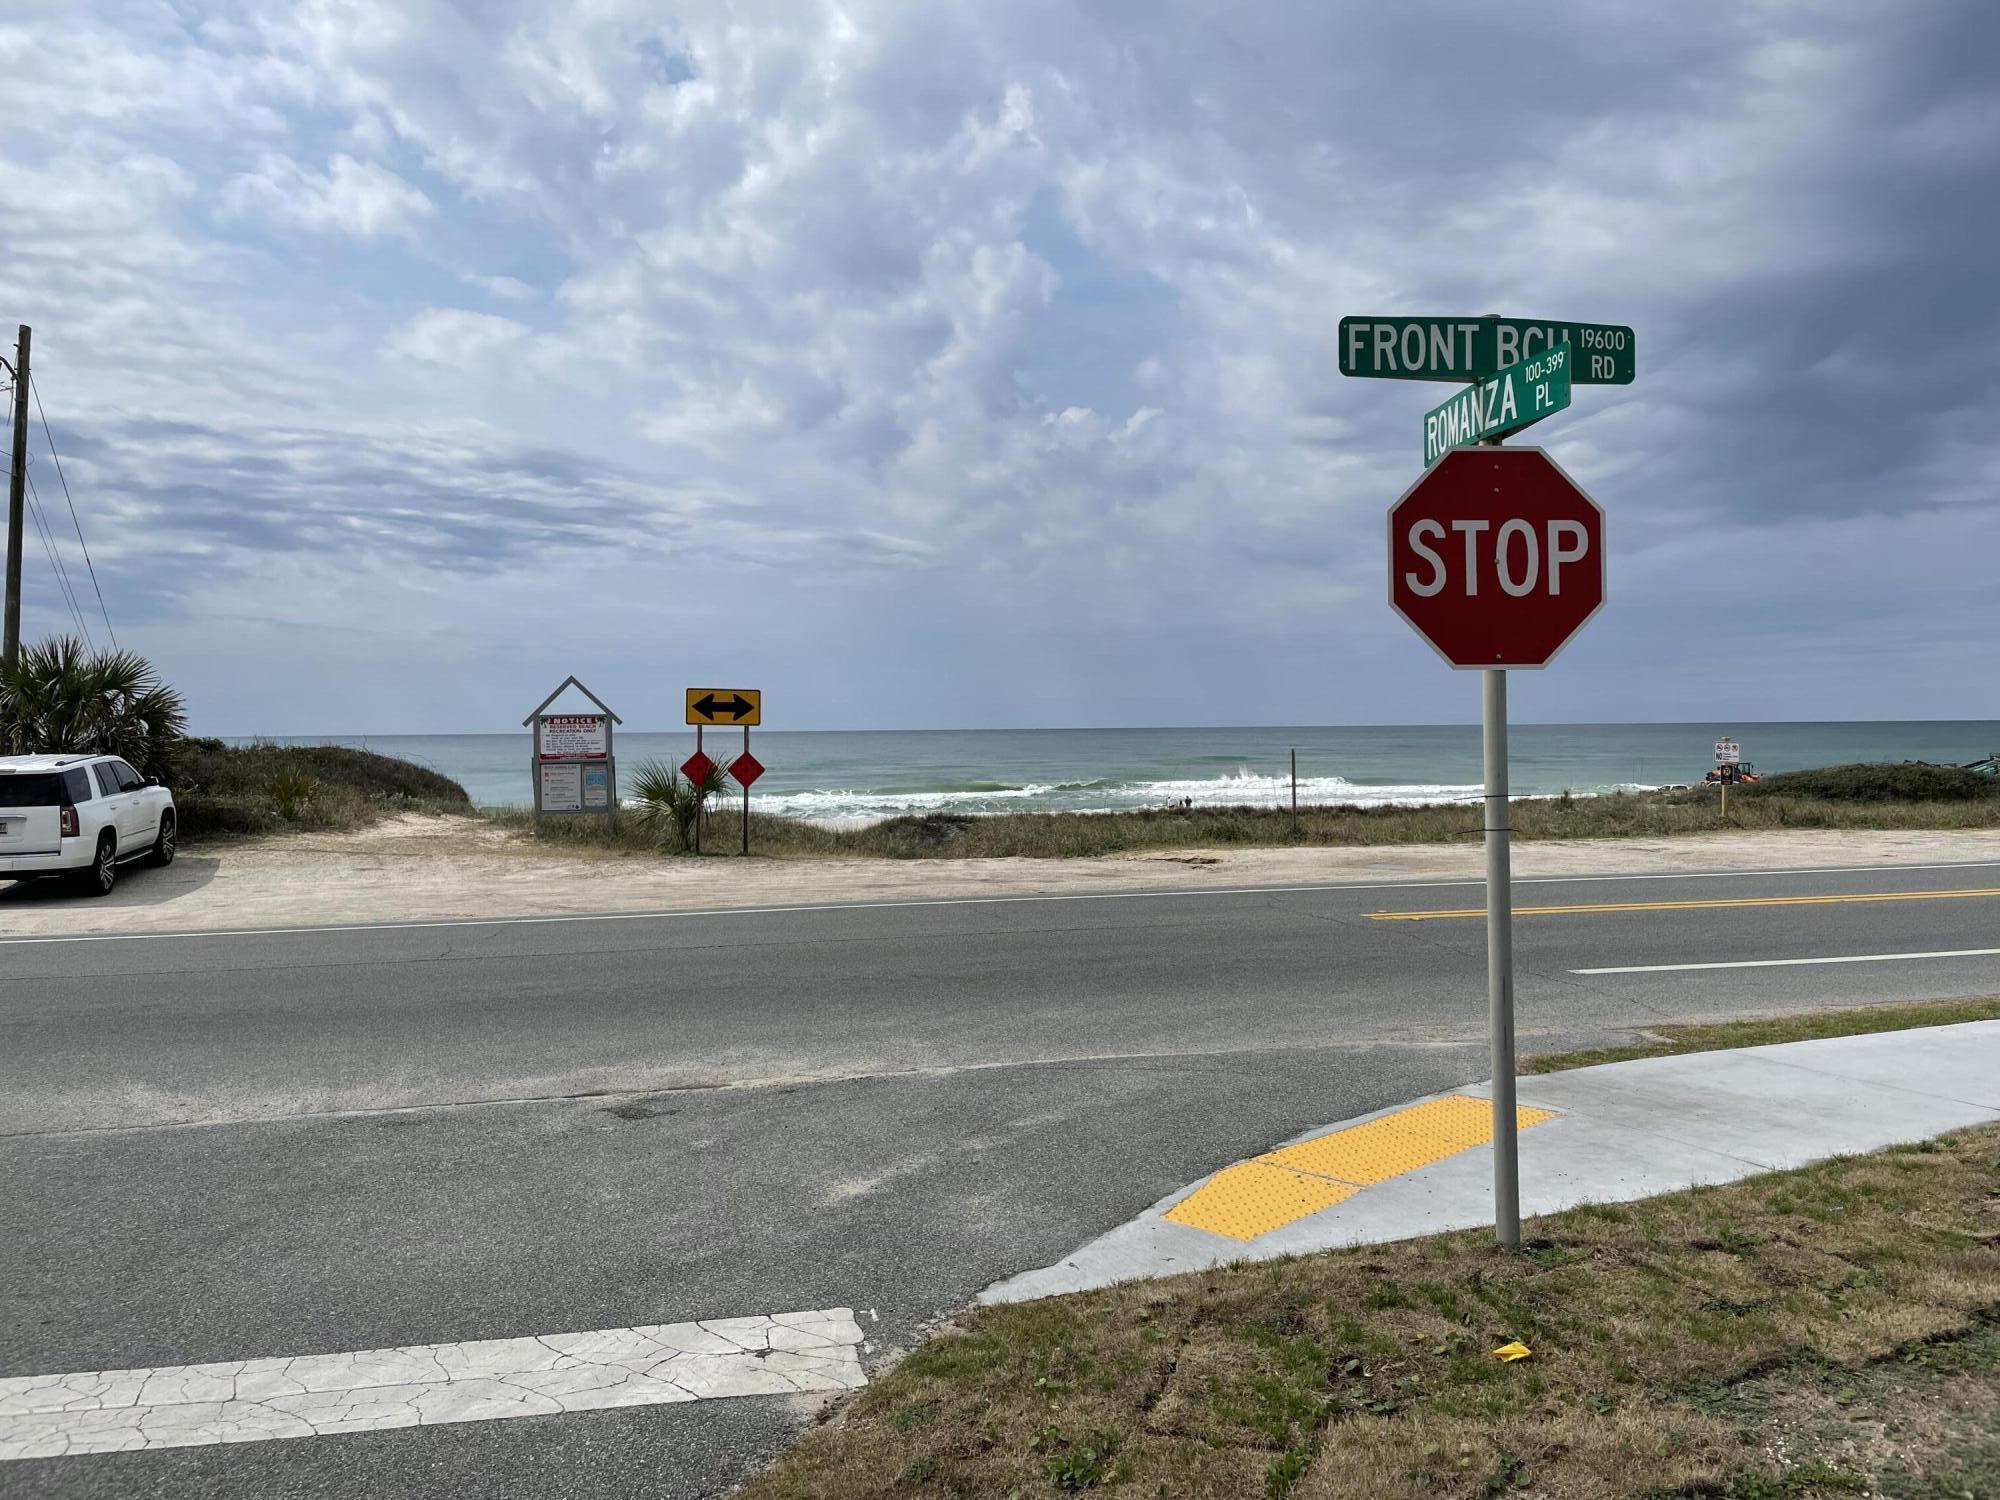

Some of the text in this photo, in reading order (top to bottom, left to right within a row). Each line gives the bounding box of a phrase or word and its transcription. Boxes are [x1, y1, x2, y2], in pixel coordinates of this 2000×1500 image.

[1349, 323, 1480, 371] FRONT
[1580, 328, 1625, 351] 19600
[1525, 351, 1565, 384] 100-399
[1591, 354, 1616, 380] RD
[1535, 381, 1554, 411] PL
[1426, 373, 1518, 460] ROMANZA
[1405, 518, 1589, 597] STOP
